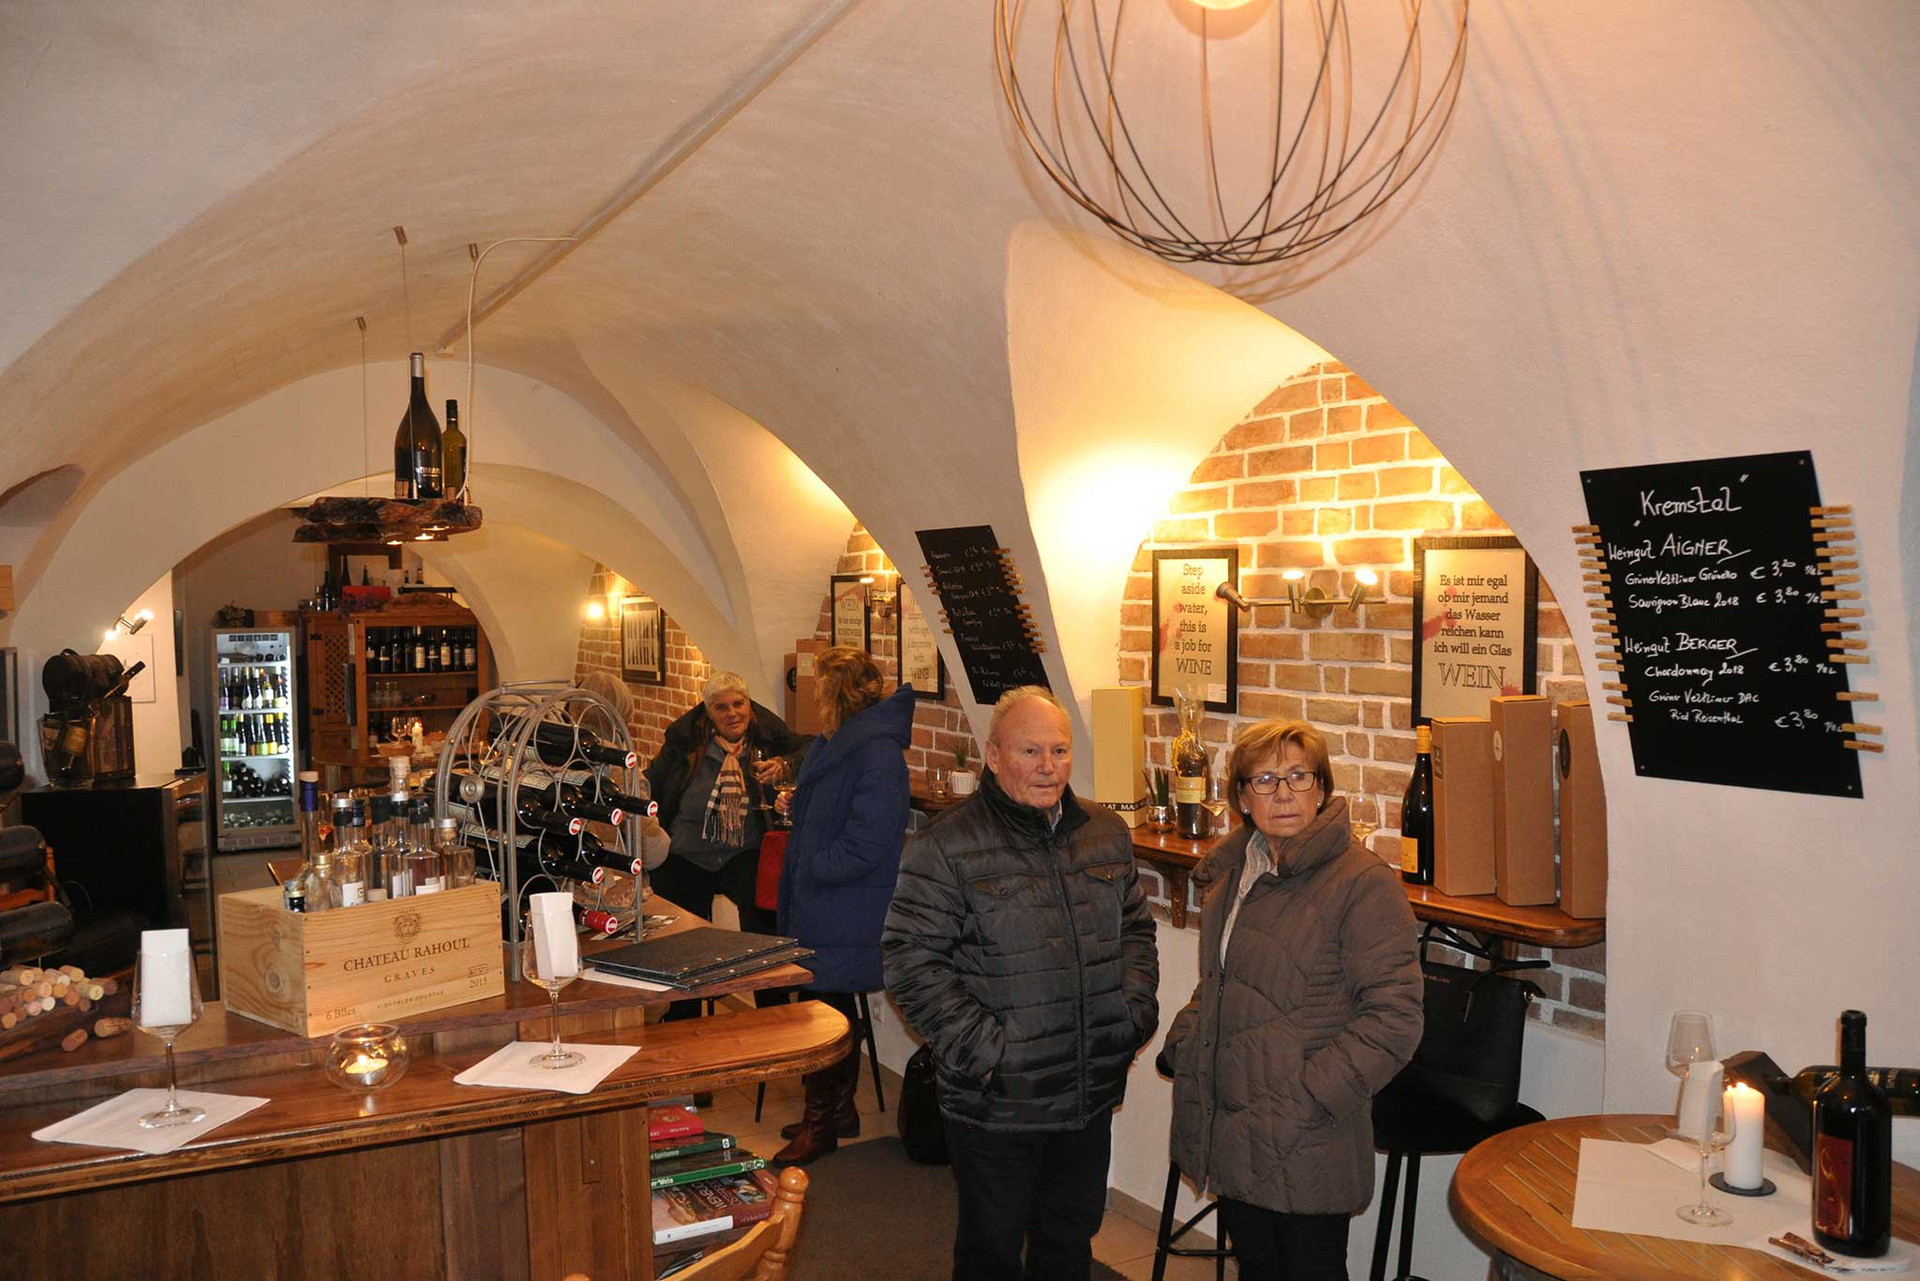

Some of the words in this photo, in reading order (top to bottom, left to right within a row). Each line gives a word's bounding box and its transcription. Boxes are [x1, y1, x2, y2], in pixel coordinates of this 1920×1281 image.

[1183, 563, 1204, 580] Step
[1181, 582, 1206, 595] aside
[1440, 574, 1451, 586] Es
[1453, 575, 1465, 586] ist
[1467, 575, 1485, 587] mir
[1486, 575, 1507, 590] egal
[1438, 592, 1451, 603] ob
[1452, 593, 1470, 604] mir
[1471, 592, 1509, 607] jemand
[1713, 592, 1740, 608] 2018
[1179, 603, 1208, 616] water,
[1446, 608, 1463, 620] das
[1464, 608, 1501, 622] Wasser
[1179, 620, 1197, 633] this
[1198, 620, 1207, 633] is
[1440, 625, 1477, 638] reichen
[1479, 626, 1504, 639] kann
[1174, 641, 1180, 650] a
[1181, 638, 1197, 655] job
[1198, 638, 1212, 653] for
[1434, 641, 1448, 654] ich
[1450, 642, 1470, 655] will
[1471, 644, 1487, 656] ein
[1490, 643, 1512, 657] Glas
[1675, 632, 1738, 655] BERGER
[1176, 657, 1212, 675] WINE
[1718, 662, 1744, 675] 2018
[1438, 662, 1506, 690] WEIN
[343, 949, 410, 972] CHATEAU
[414, 937, 470, 958] RAHOUL
[384, 966, 435, 984] GRAVES
[469, 976, 488, 989] 2015
[325, 1011, 332, 1021] 6
